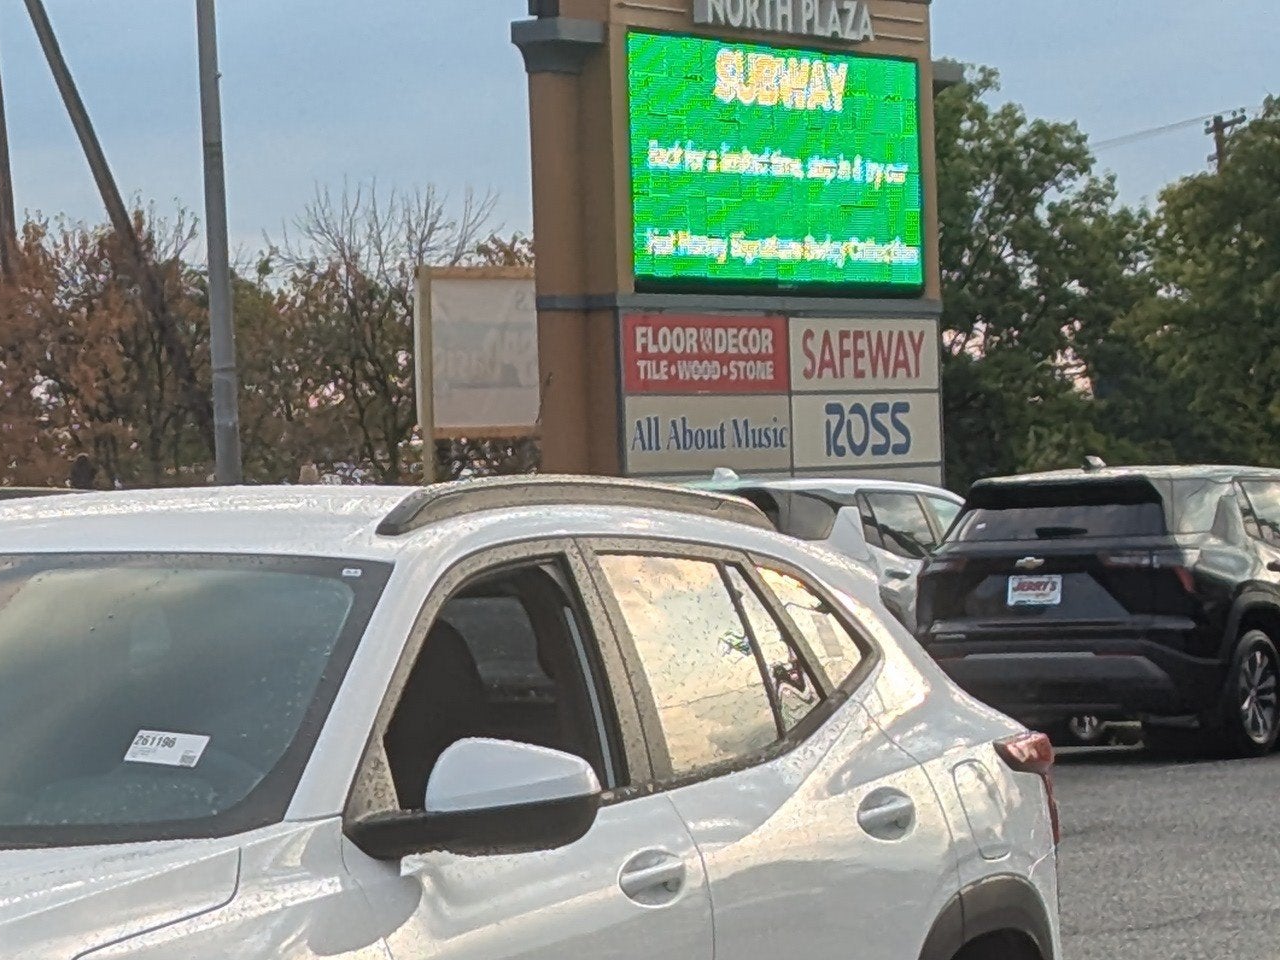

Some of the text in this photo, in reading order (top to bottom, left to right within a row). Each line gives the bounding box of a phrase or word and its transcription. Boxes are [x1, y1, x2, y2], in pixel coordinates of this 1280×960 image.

[707, 0, 874, 41] NORTH PLAZA
[714, 48, 848, 112] SUBWAY
[635, 326, 698, 353] FLOOR
[714, 328, 773, 354] DECOR
[802, 328, 925, 380] SAFEWAY
[636, 360, 774, 380] TILE WOOD STONE
[631, 416, 788, 450] All About Music
[824, 402, 911, 457] ROSS
